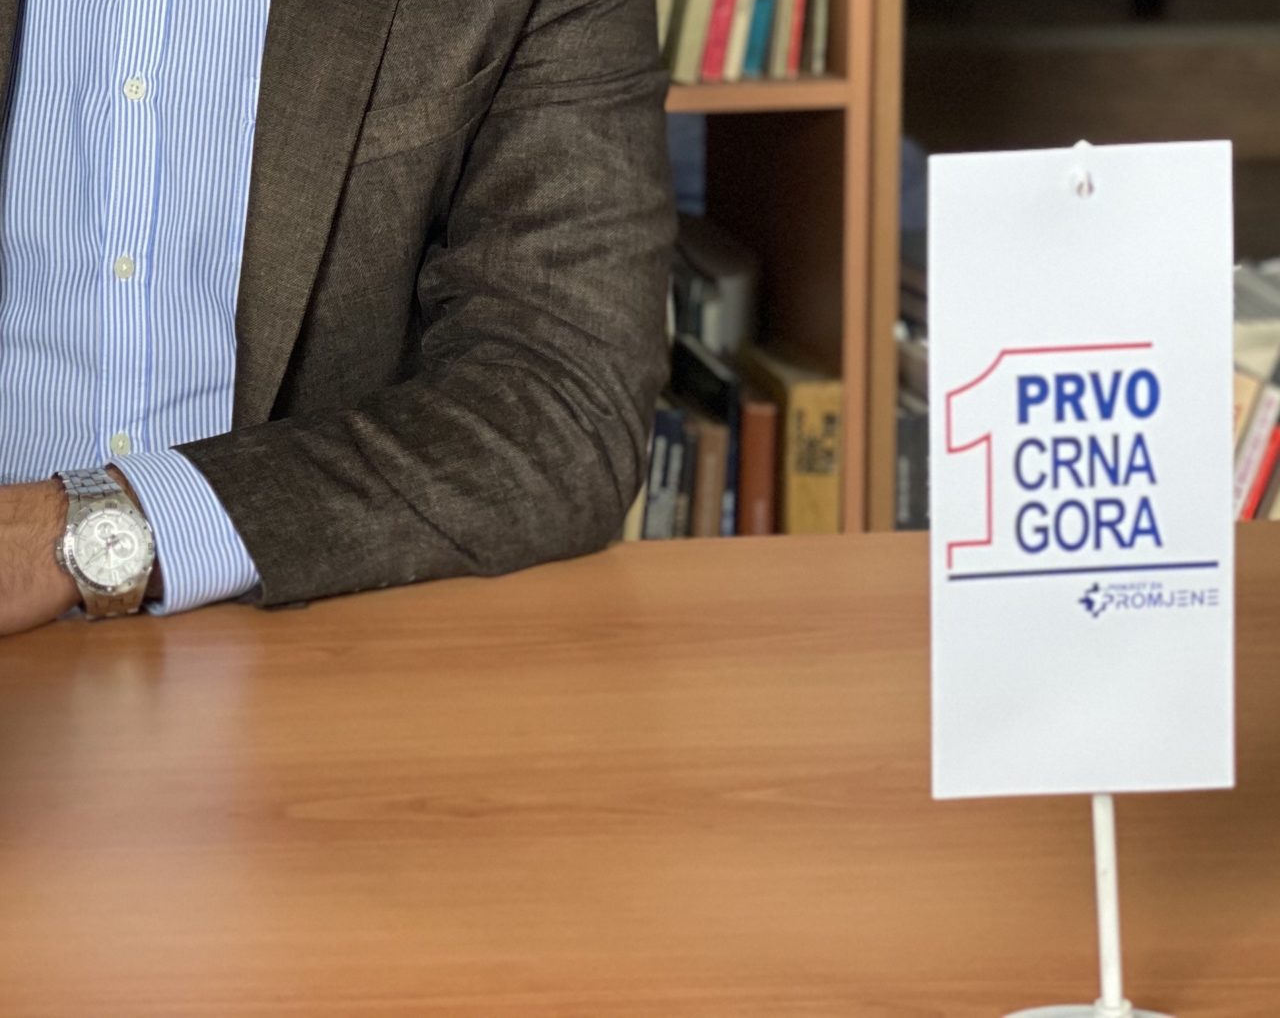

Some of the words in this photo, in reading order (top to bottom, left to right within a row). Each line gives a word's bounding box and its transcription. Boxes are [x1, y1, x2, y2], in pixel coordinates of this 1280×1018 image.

[1016, 368, 1161, 425] PRVO
[1013, 431, 1157, 491] CRNA
[1014, 495, 1163, 554] GORA
[1104, 588, 1219, 609] PROMJENE
